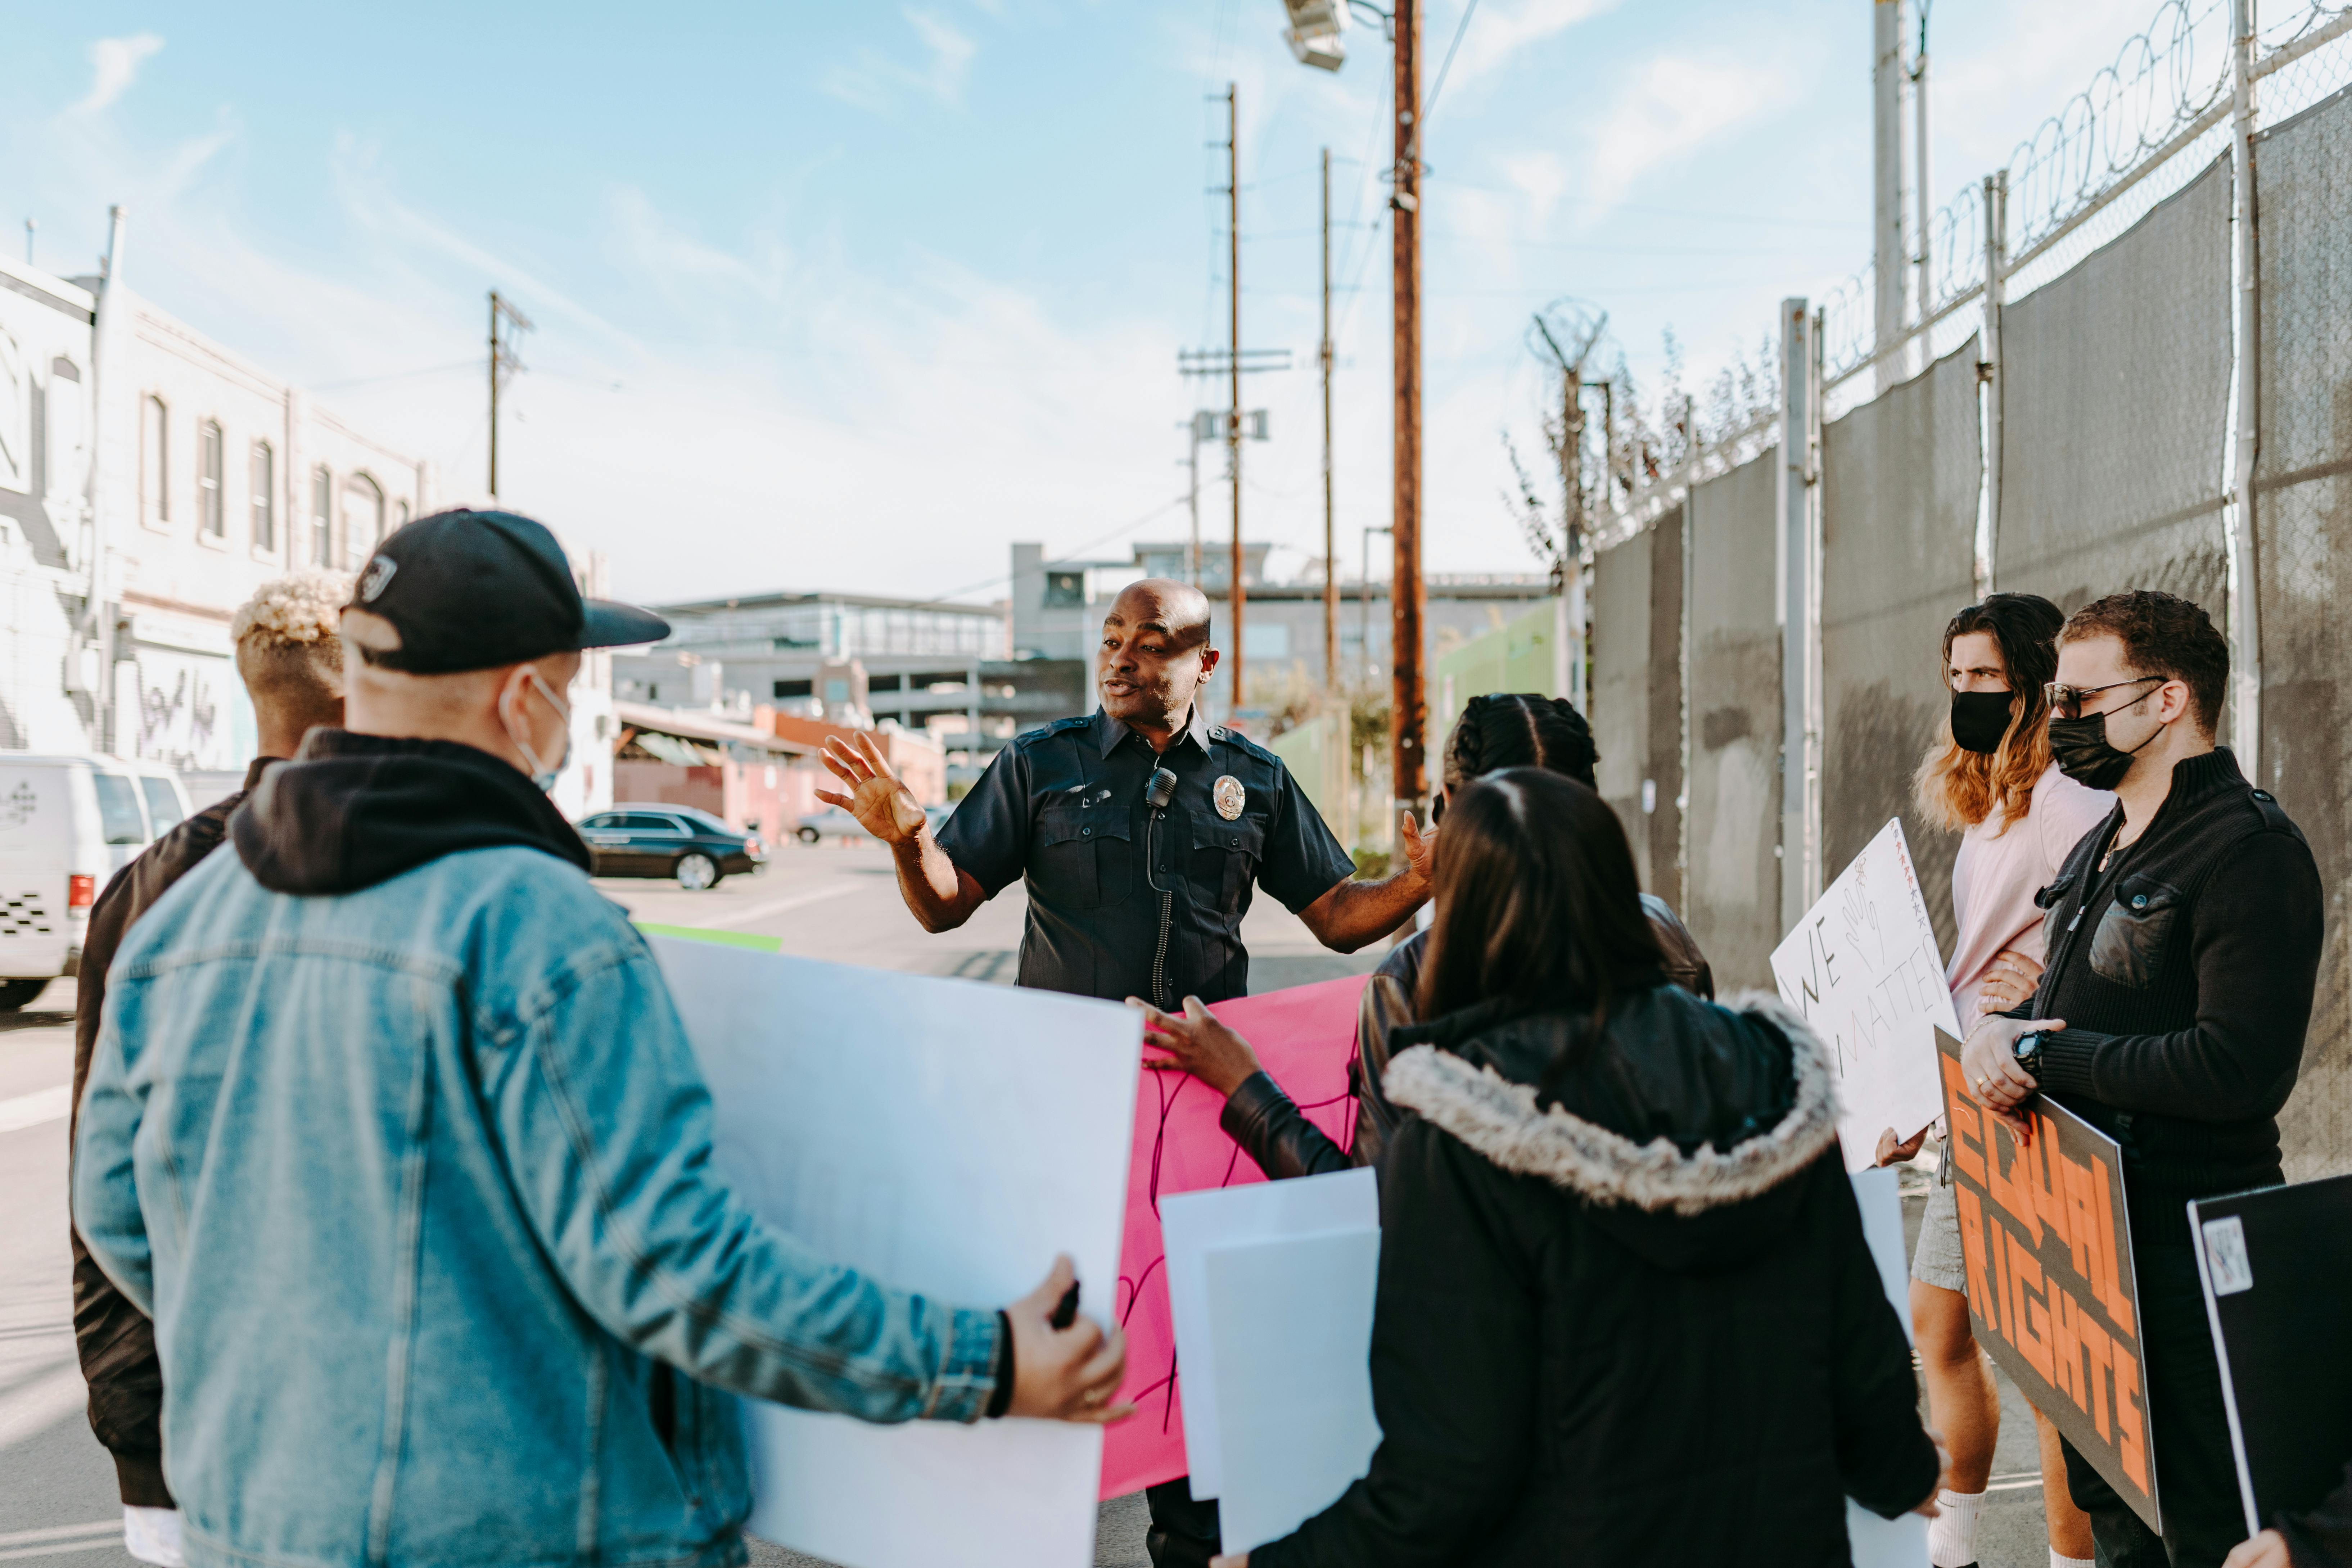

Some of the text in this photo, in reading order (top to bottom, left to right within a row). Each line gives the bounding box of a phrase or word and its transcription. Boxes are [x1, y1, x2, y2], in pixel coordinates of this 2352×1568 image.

[1779, 916, 1840, 1021] WE
[1837, 934, 1948, 1079] MATTER
[1942, 1052, 2135, 1339] EQUAL
[1955, 1180, 2149, 1497] RIGHTS
